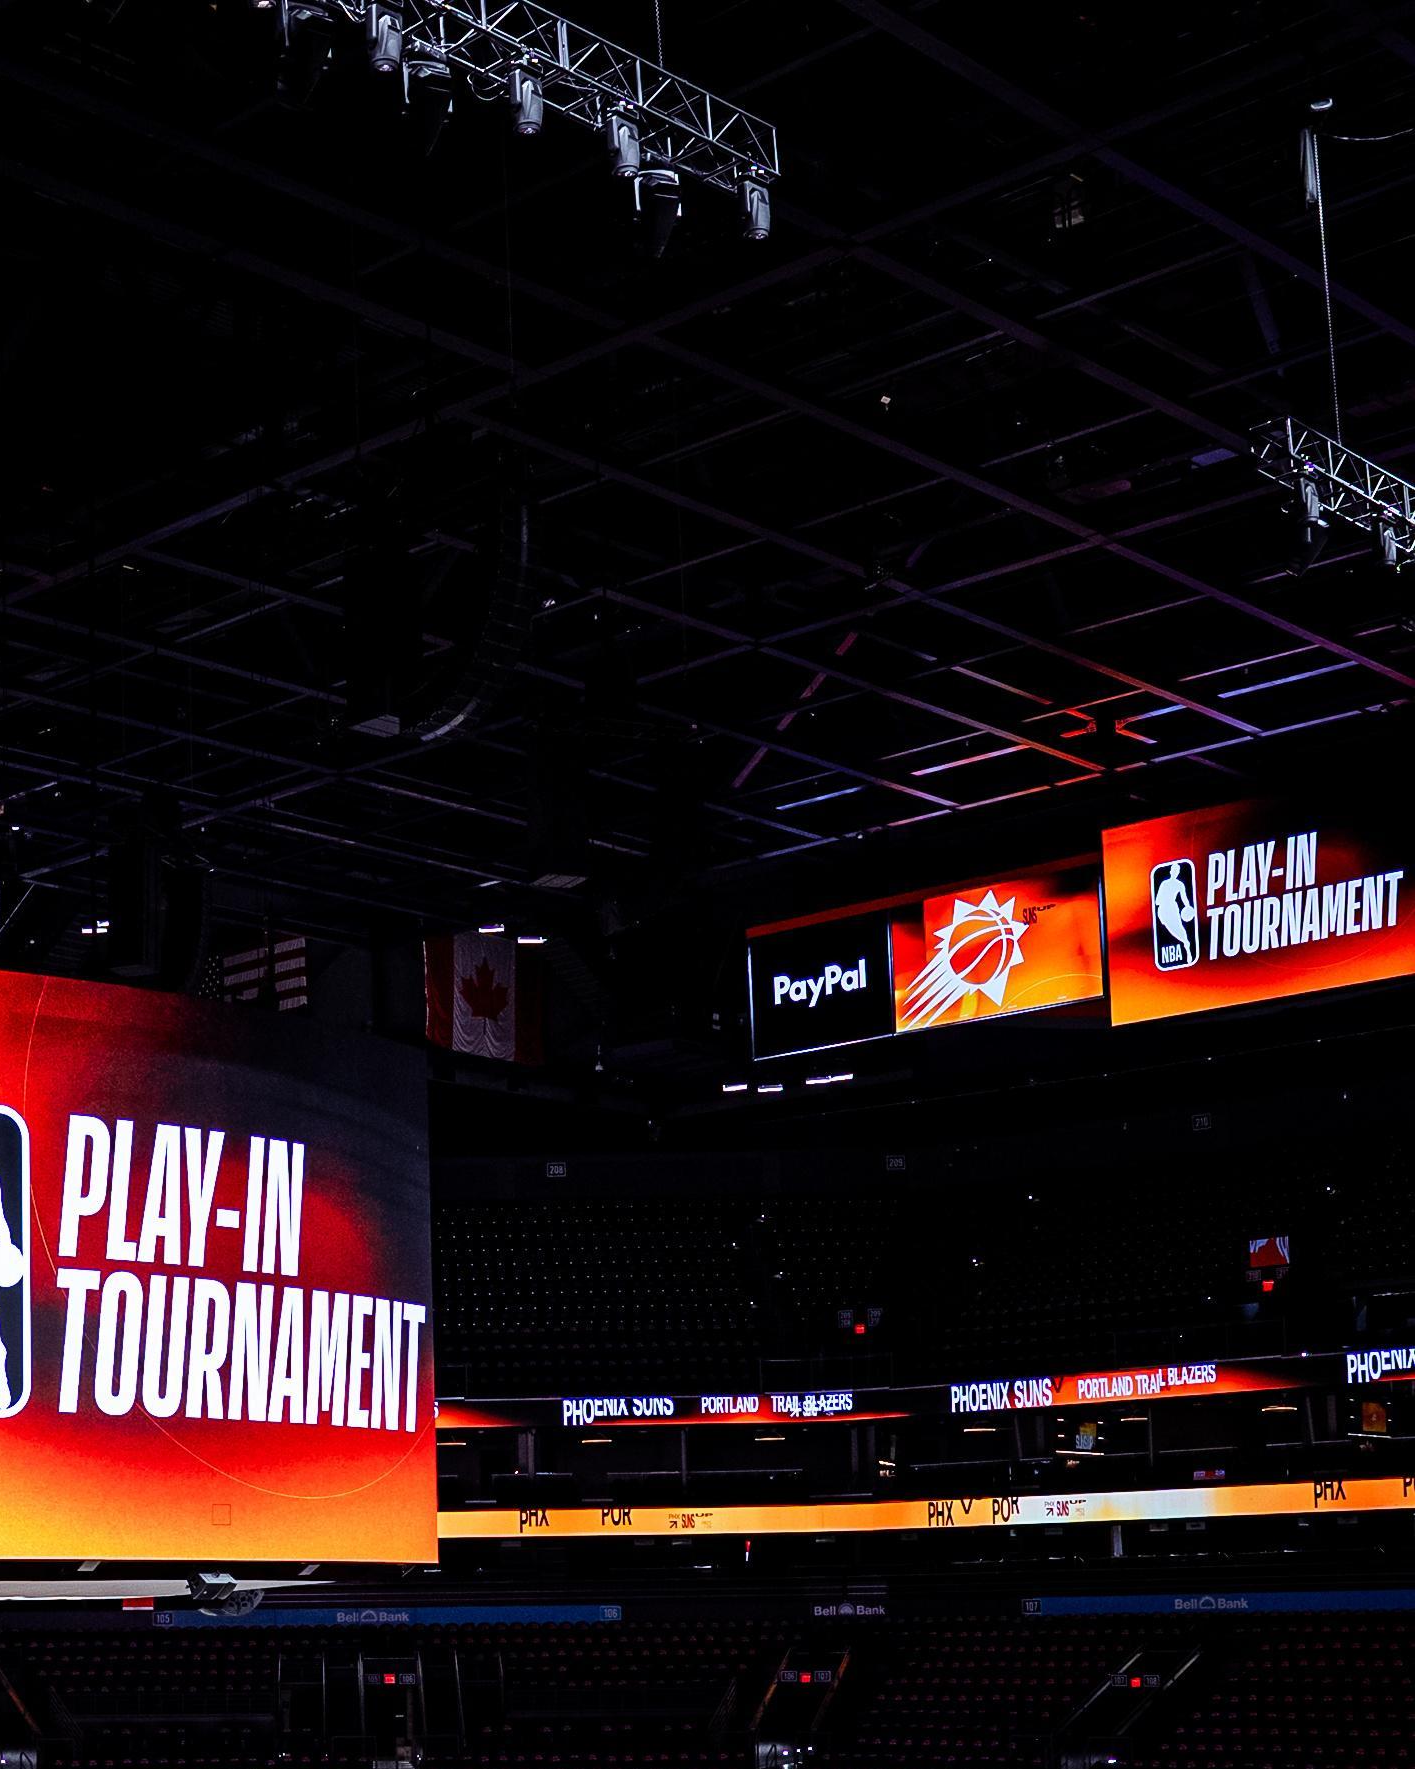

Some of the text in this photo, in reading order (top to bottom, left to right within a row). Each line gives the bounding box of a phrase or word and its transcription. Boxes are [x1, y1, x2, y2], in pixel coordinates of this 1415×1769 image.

[1207, 831, 1318, 906] PLAY-IN
[1206, 870, 1404, 961] TOURNAMENT
[1161, 944, 1183, 964] NBA
[773, 958, 867, 1008] PayPal
[57, 1113, 306, 1277] PLAY-IN
[56, 1268, 426, 1433] TOURNAMENT
[951, 1381, 1012, 1413] PHOENIX
[1014, 1378, 1053, 1408] SUNS
[1077, 1375, 1133, 1400] PORTLAND
[1136, 1369, 1166, 1396] TRAIL
[1168, 1364, 1217, 1386] BLAZERS
[562, 1398, 629, 1426] PHOENIX
[632, 1398, 674, 1417] SUNS
[701, 1396, 759, 1415] PORTLAND
[1313, 1480, 1347, 1509] PHX
[518, 1507, 633, 1533] PHX POR
[928, 1501, 955, 1527] PHX
[993, 1497, 1020, 1525] POR
[336, 1610, 410, 1624] Bell Bank
[603, 1607, 619, 1619] 106
[813, 1604, 886, 1617] Bell Bank
[1174, 1598, 1249, 1610] Bell Bank
[156, 1613, 171, 1625] 105
